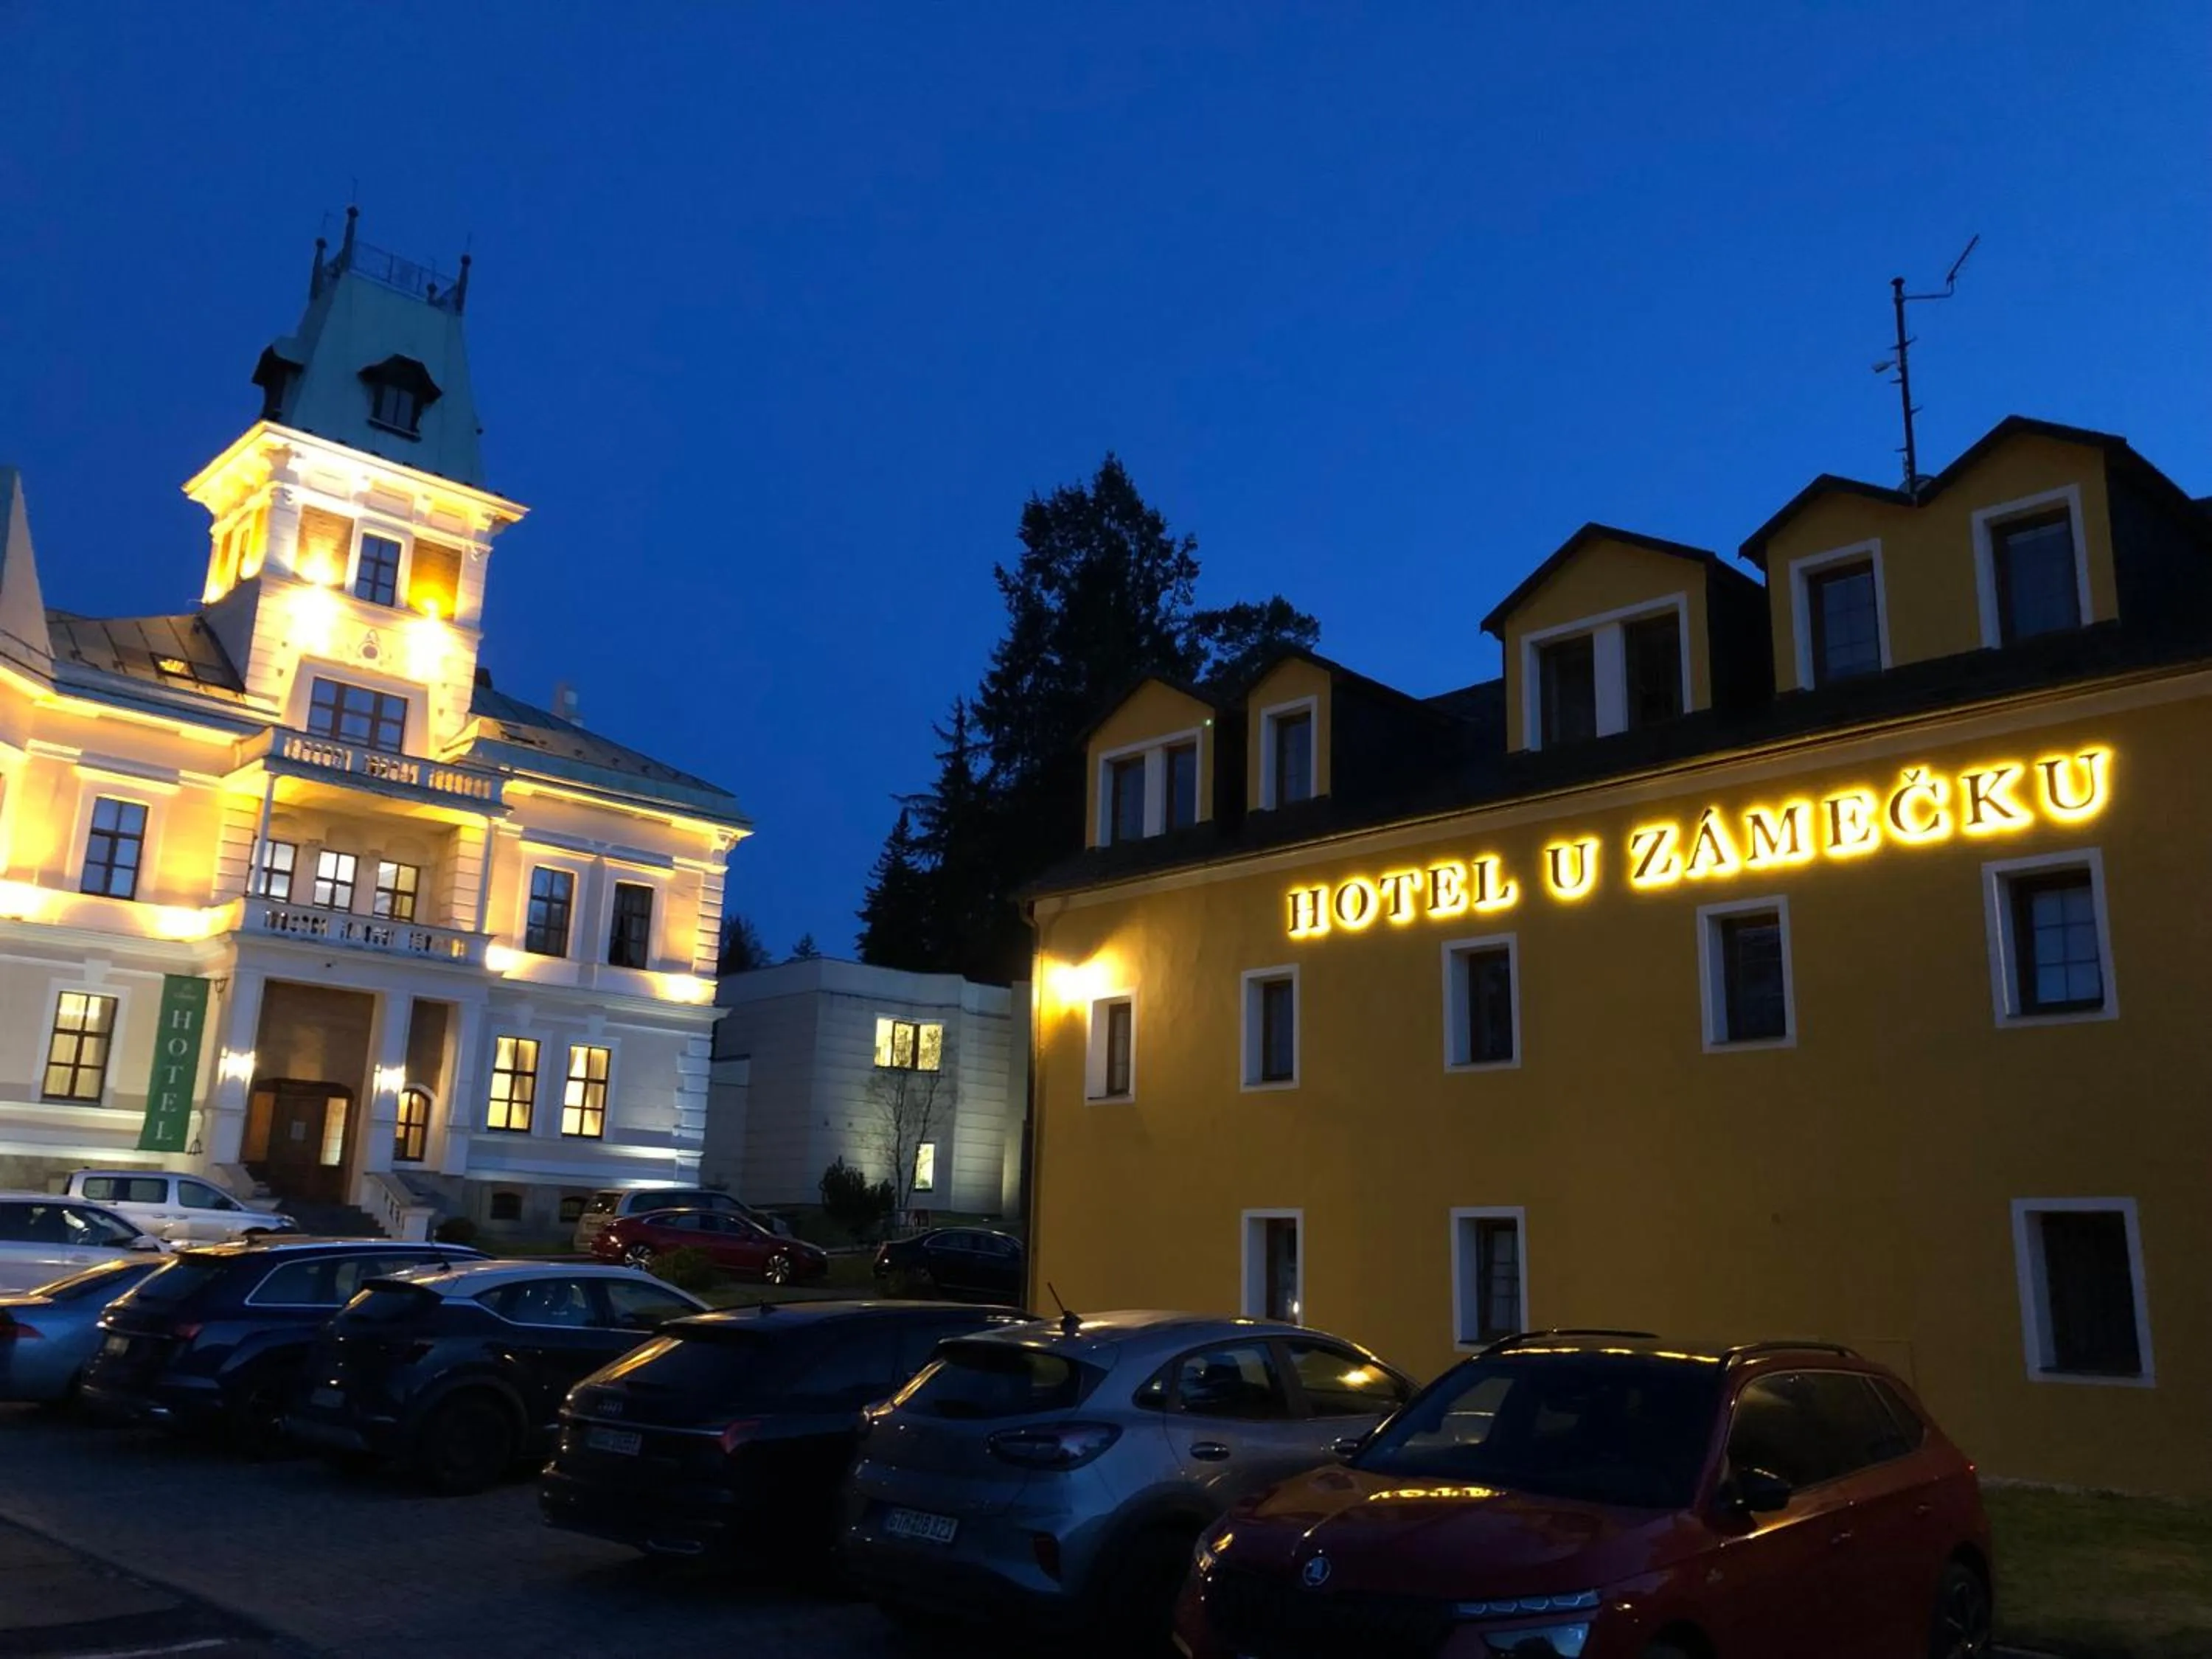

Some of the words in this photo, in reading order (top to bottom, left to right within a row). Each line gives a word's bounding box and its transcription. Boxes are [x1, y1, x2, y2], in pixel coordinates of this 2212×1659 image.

[1287, 858, 1512, 933] HOTEL
[1545, 841, 1593, 892] U
[1630, 752, 2101, 880] ZÁMEČKU
[155, 1009, 193, 1141] HOTEL
